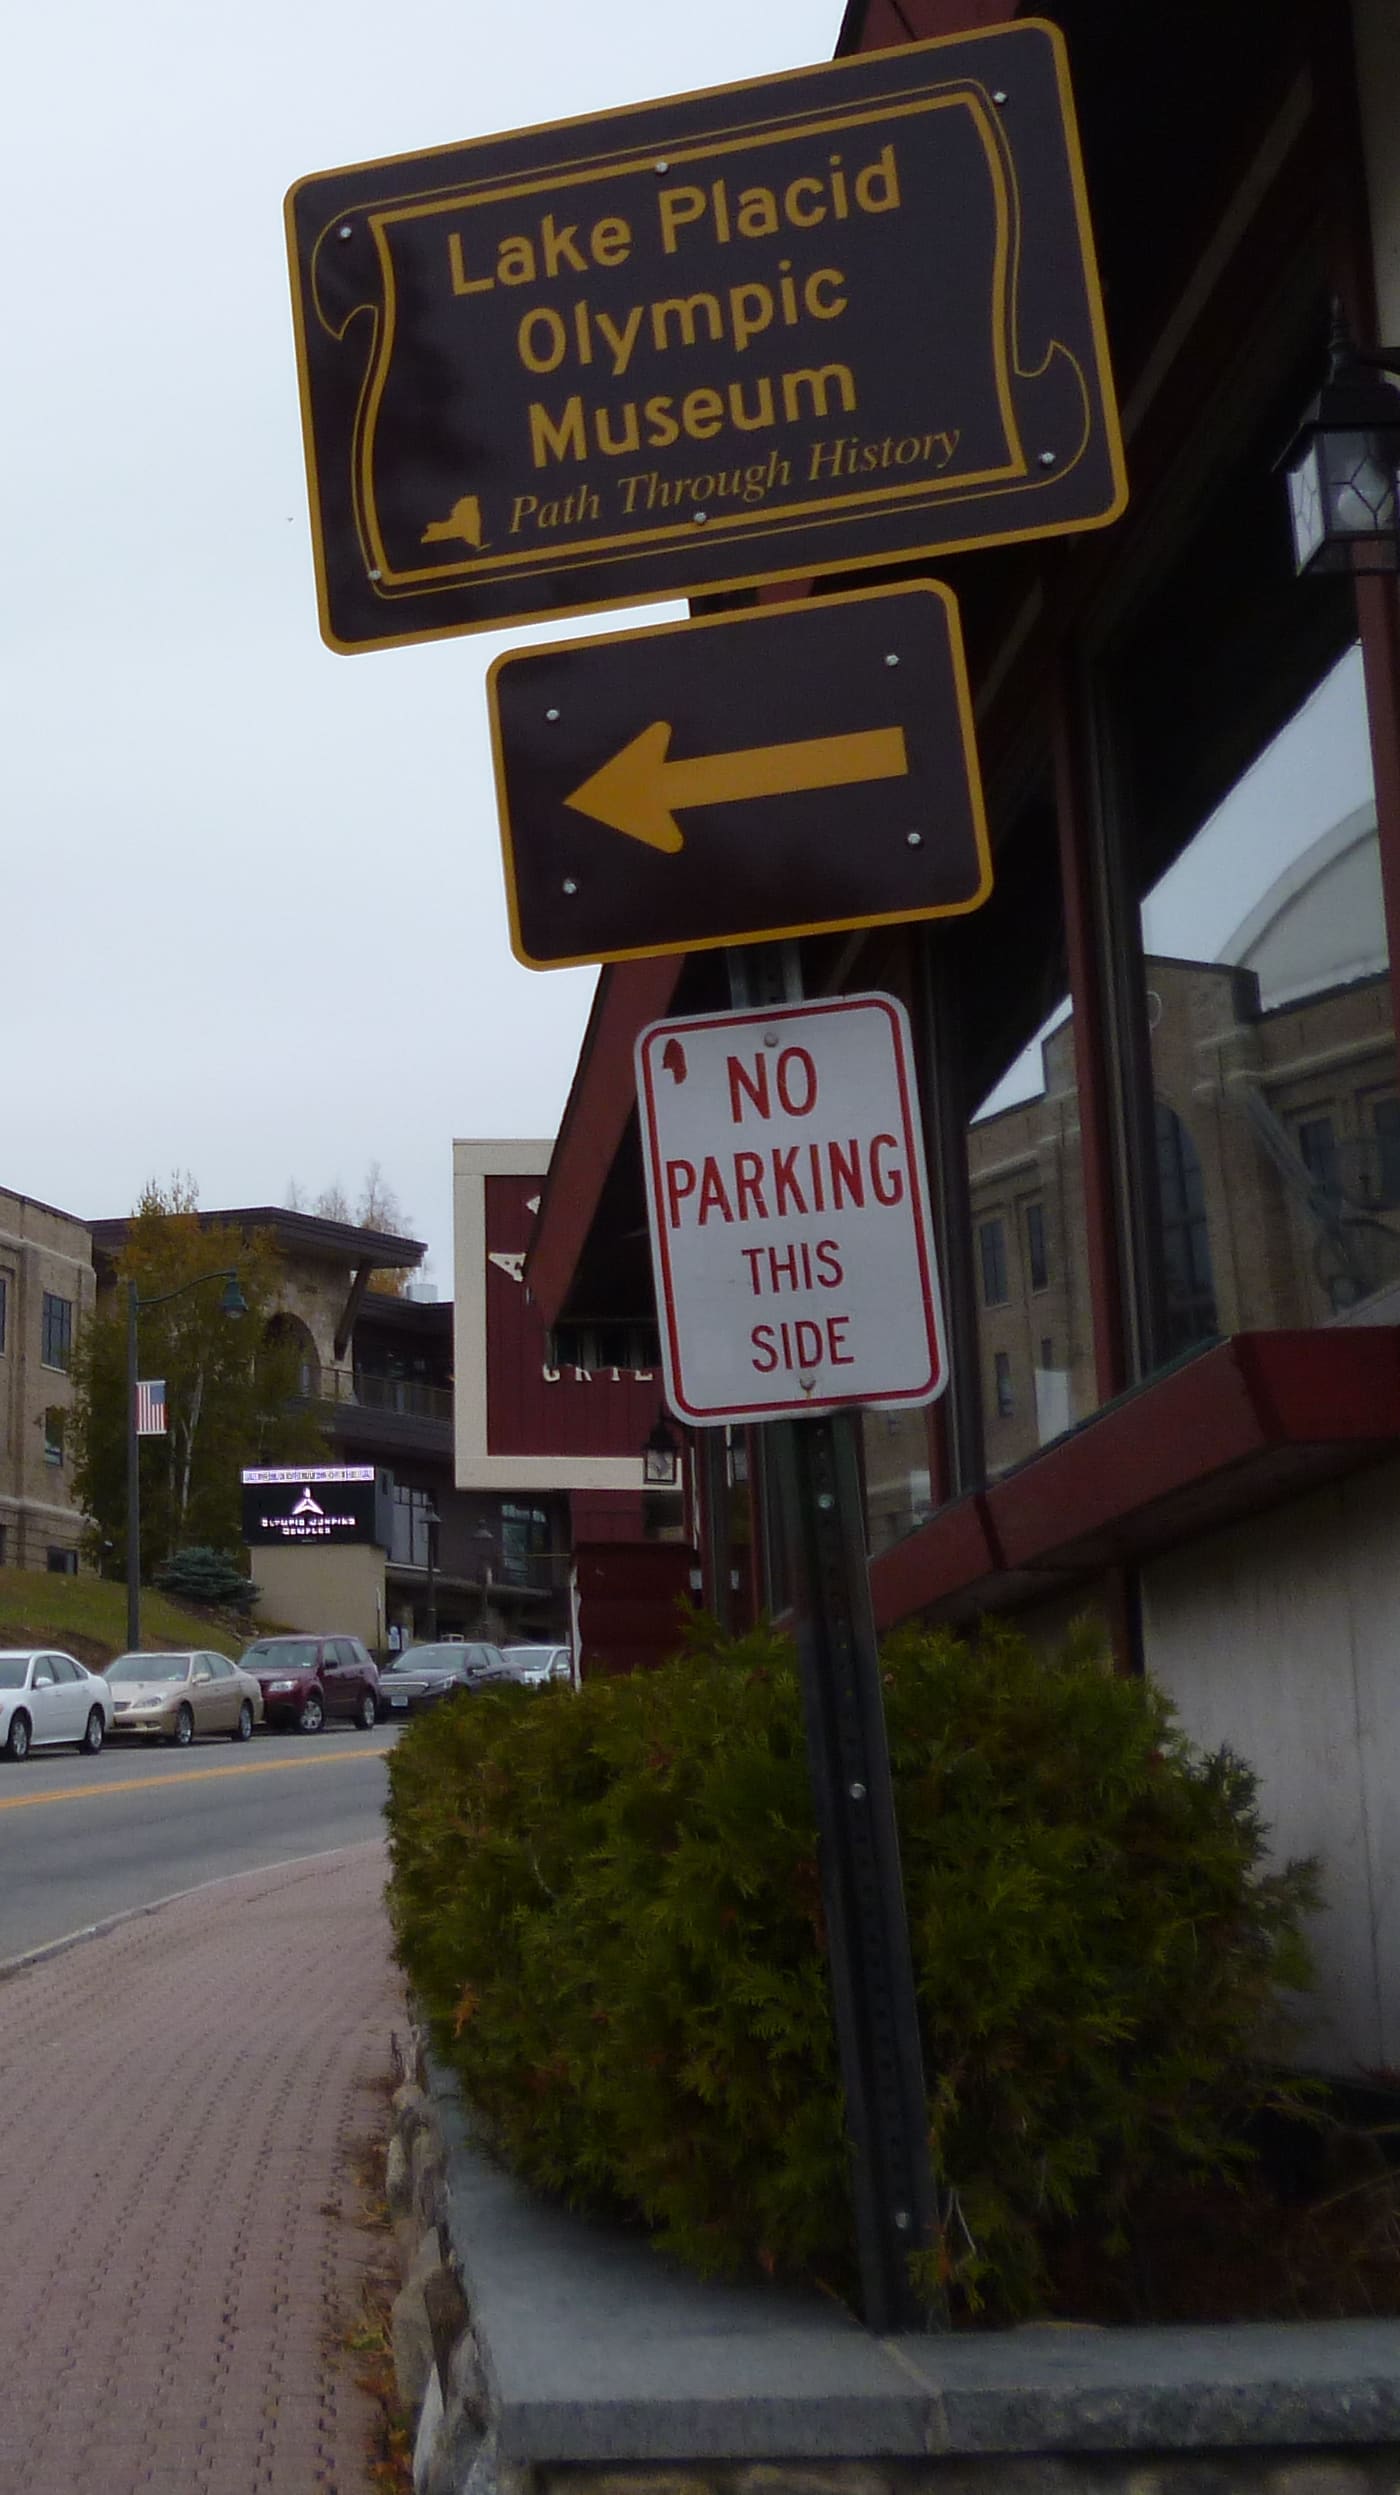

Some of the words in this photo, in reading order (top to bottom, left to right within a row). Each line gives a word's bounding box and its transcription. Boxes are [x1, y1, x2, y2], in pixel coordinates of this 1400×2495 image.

[447, 213, 633, 296] Lake
[657, 145, 901, 254] Placid
[516, 259, 849, 375] Olympic
[528, 361, 857, 468] Museum
[508, 486, 601, 534] Path
[617, 450, 791, 515] Through
[807, 428, 961, 481] History
[727, 1046, 817, 1123] NO
[666, 1133, 904, 1229] PARKING
[741, 1239, 844, 1295] THIS
[751, 1316, 854, 1373] SIDE
